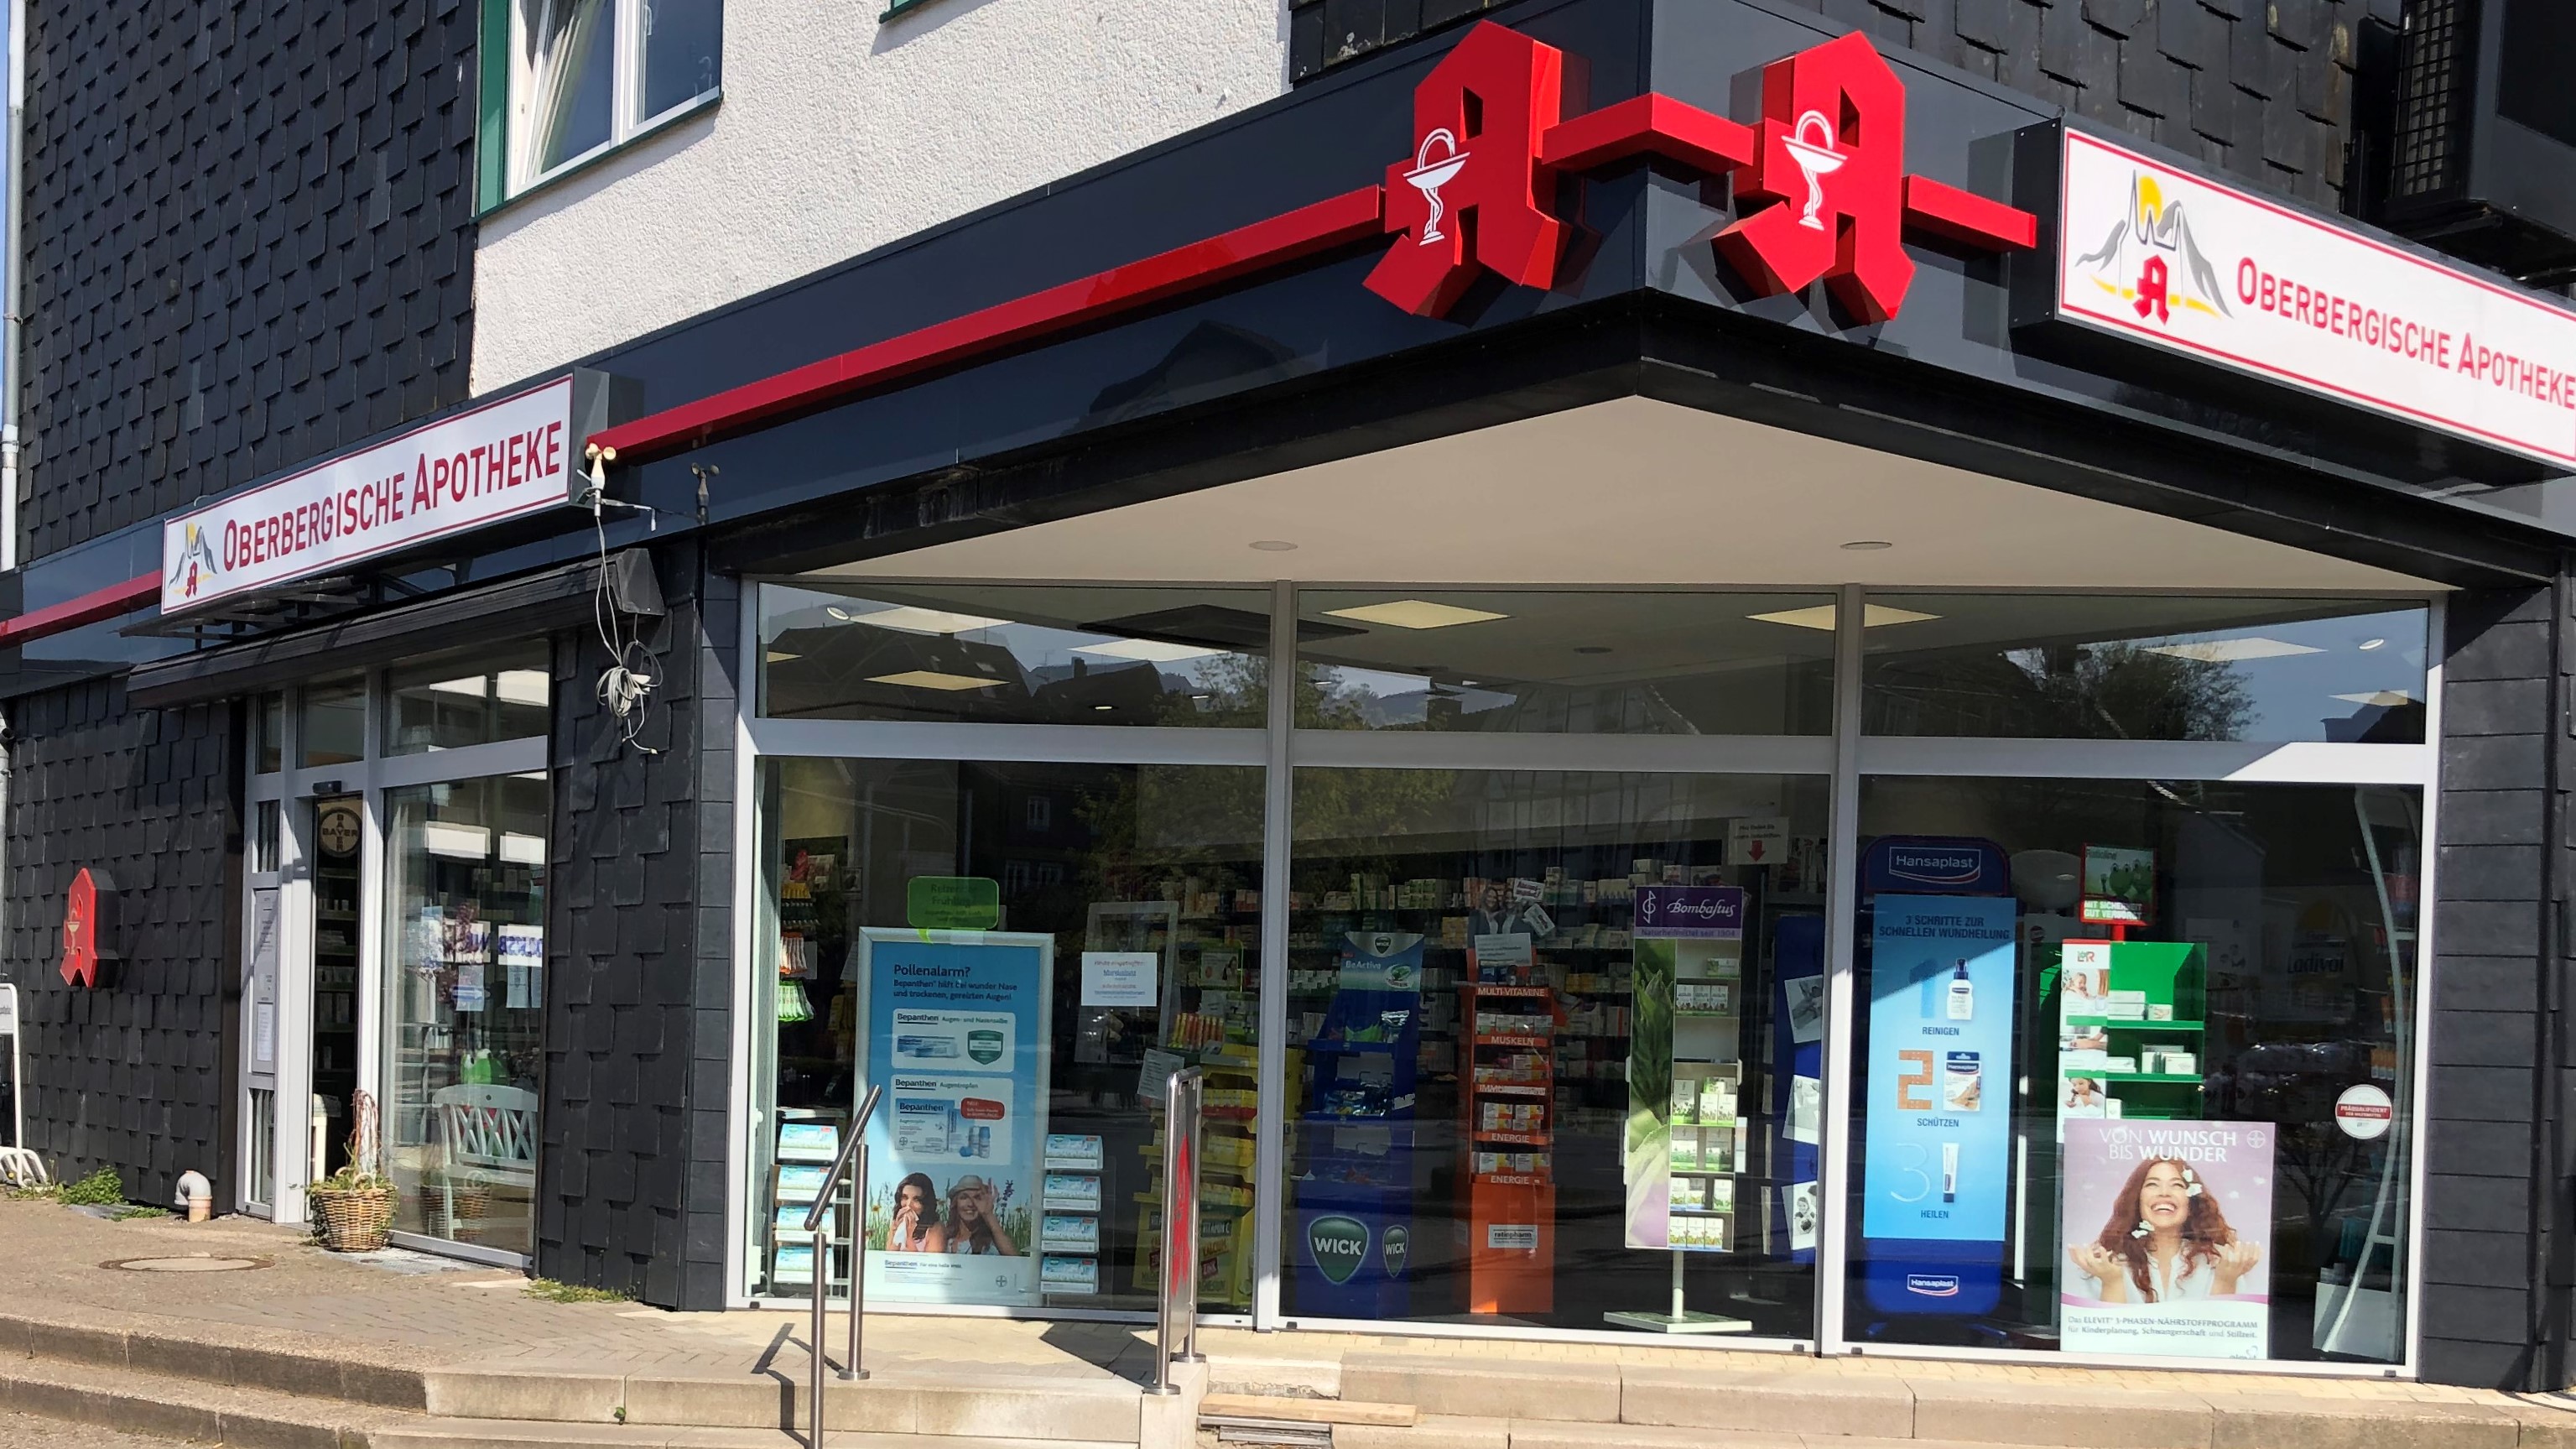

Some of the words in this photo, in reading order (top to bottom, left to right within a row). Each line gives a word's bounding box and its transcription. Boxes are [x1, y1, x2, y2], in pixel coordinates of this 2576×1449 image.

[2236, 257, 2452, 369] OBERBERGISCHE
[223, 472, 405, 572] OBERBERGISCHE
[411, 420, 562, 515] APOTHEKE
[322, 827, 357, 837] BAYER
[1896, 855, 1974, 869] Hansaplast
[1914, 915, 1961, 926] SCHRITTE
[1965, 916, 1985, 927] ZUR
[1879, 926, 1936, 937] SCHNELLEN
[1939, 928, 2010, 940] WUNDHEILUNG
[893, 964, 971, 977] Pollenalarm?
[968, 981, 997, 990] wunder
[998, 983, 1017, 991] Nase
[1922, 1026, 1959, 1036] REINIGEN
[1491, 1036, 1535, 1046] MUSKELN
[896, 1079, 937, 1088] Bepanthen
[1897, 1050, 1933, 1110] 2
[899, 1102, 944, 1112] Bepanthen
[1917, 1117, 1959, 1128] SCHÜTZEN
[1491, 1134, 1530, 1143] ENERGIE
[2099, 1128, 2142, 1144] VON
[2147, 1129, 2236, 1146] WUNSCH
[2109, 1144, 2133, 1160] BIS
[2138, 1145, 2227, 1162] WUNDER
[1891, 1142, 1930, 1203] 3
[1491, 1175, 1529, 1184] ENERGIE
[1920, 1210, 1949, 1219] HEILEN
[1314, 1237, 1361, 1255] WICK
[1385, 1243, 1405, 1255] WICK
[1911, 1279, 1954, 1288] Hansaplast
[2209, 1329, 2225, 1337] und
